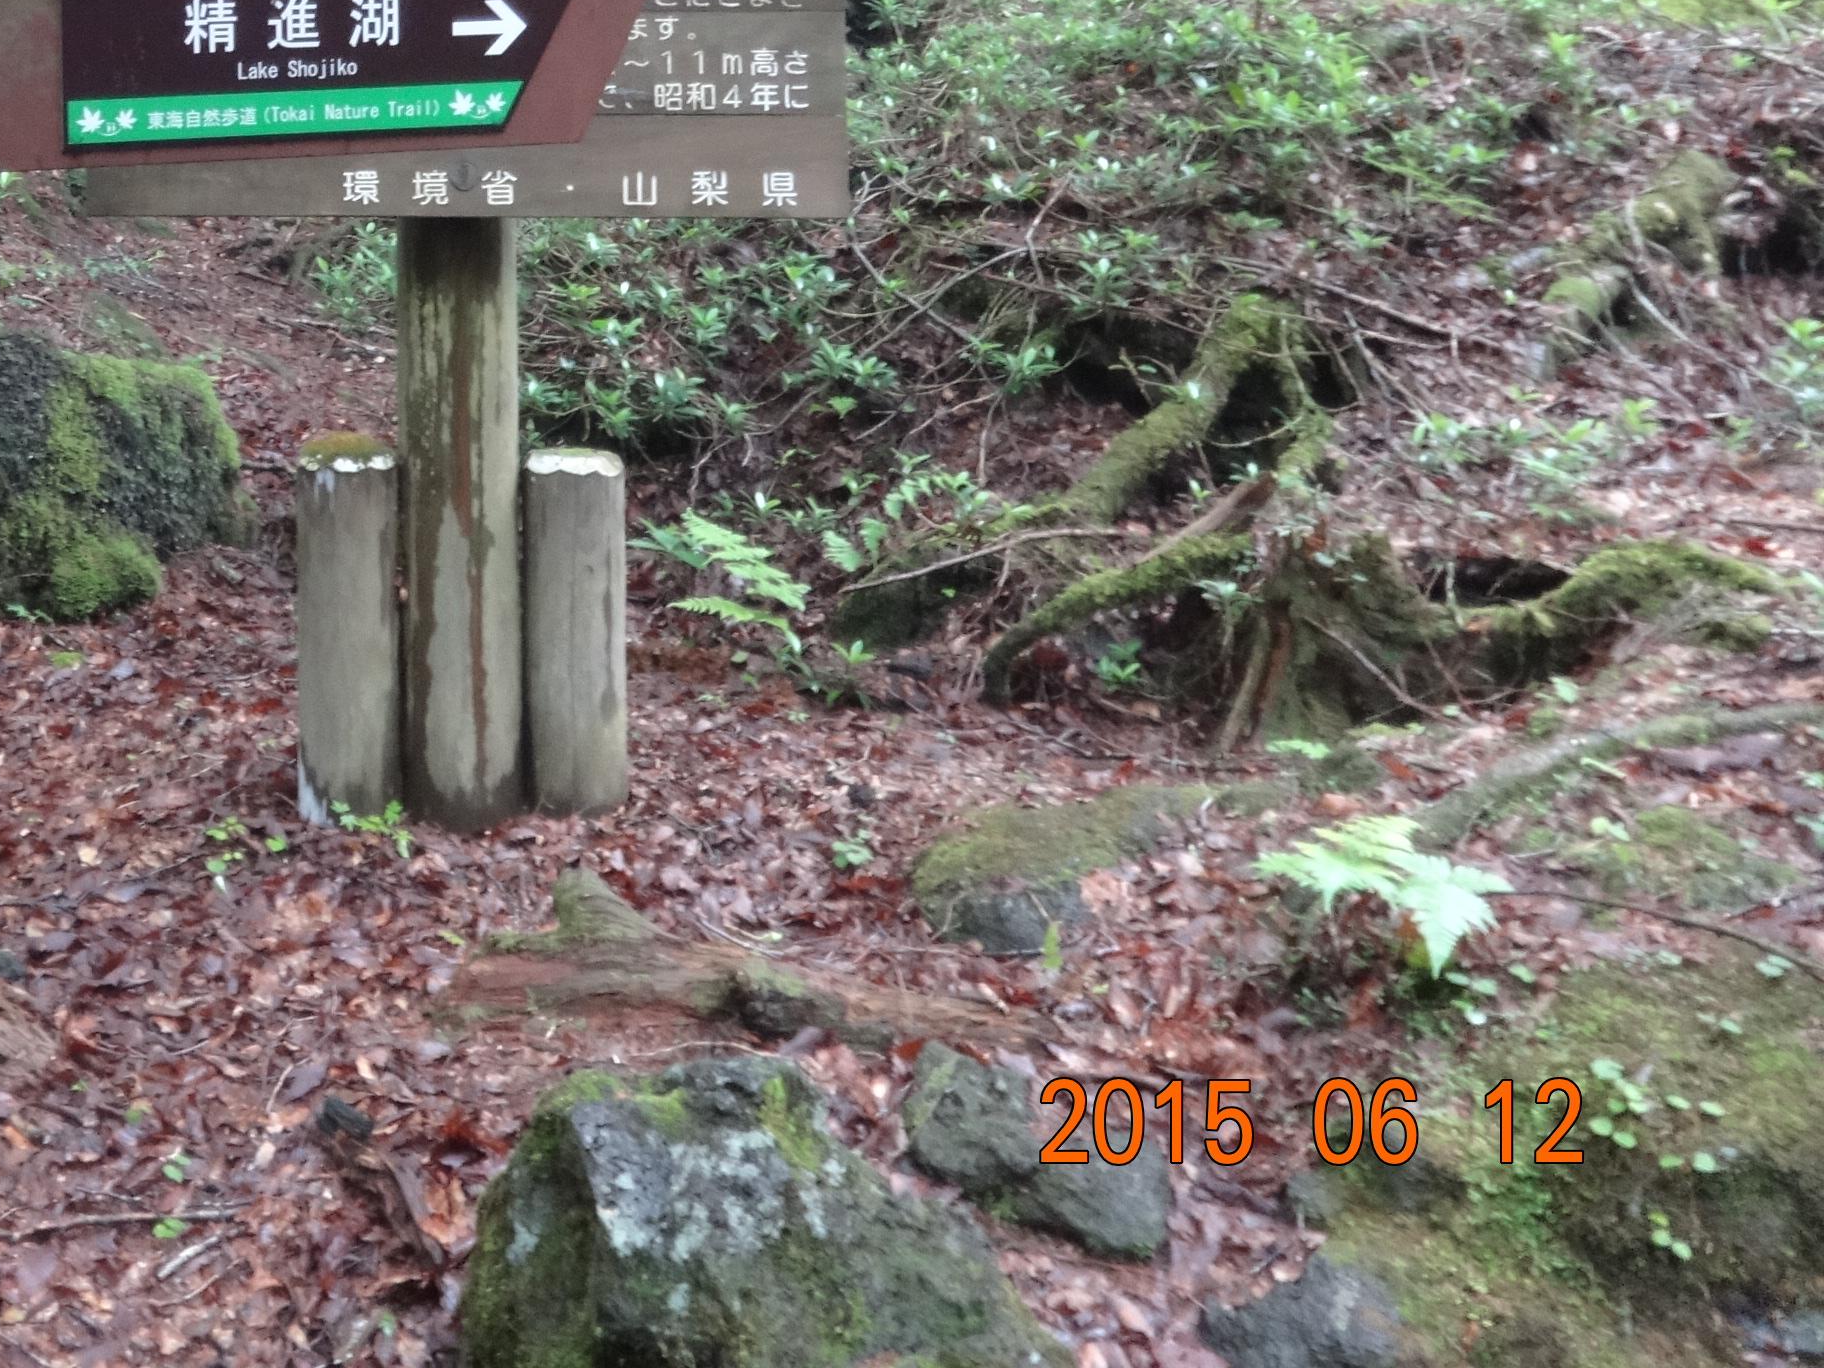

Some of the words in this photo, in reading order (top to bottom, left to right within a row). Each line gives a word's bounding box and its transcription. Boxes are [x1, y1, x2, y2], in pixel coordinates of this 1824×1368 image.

[237, 61, 279, 81] Lake
[287, 59, 358, 80] Shojiko
[147, 106, 258, 130] 東海自然歩道
[263, 104, 315, 125] (Tokai
[324, 103, 380, 121] Nature
[387, 99, 441, 118] Trail)
[341, 169, 799, 207] 環境省・山梨県
